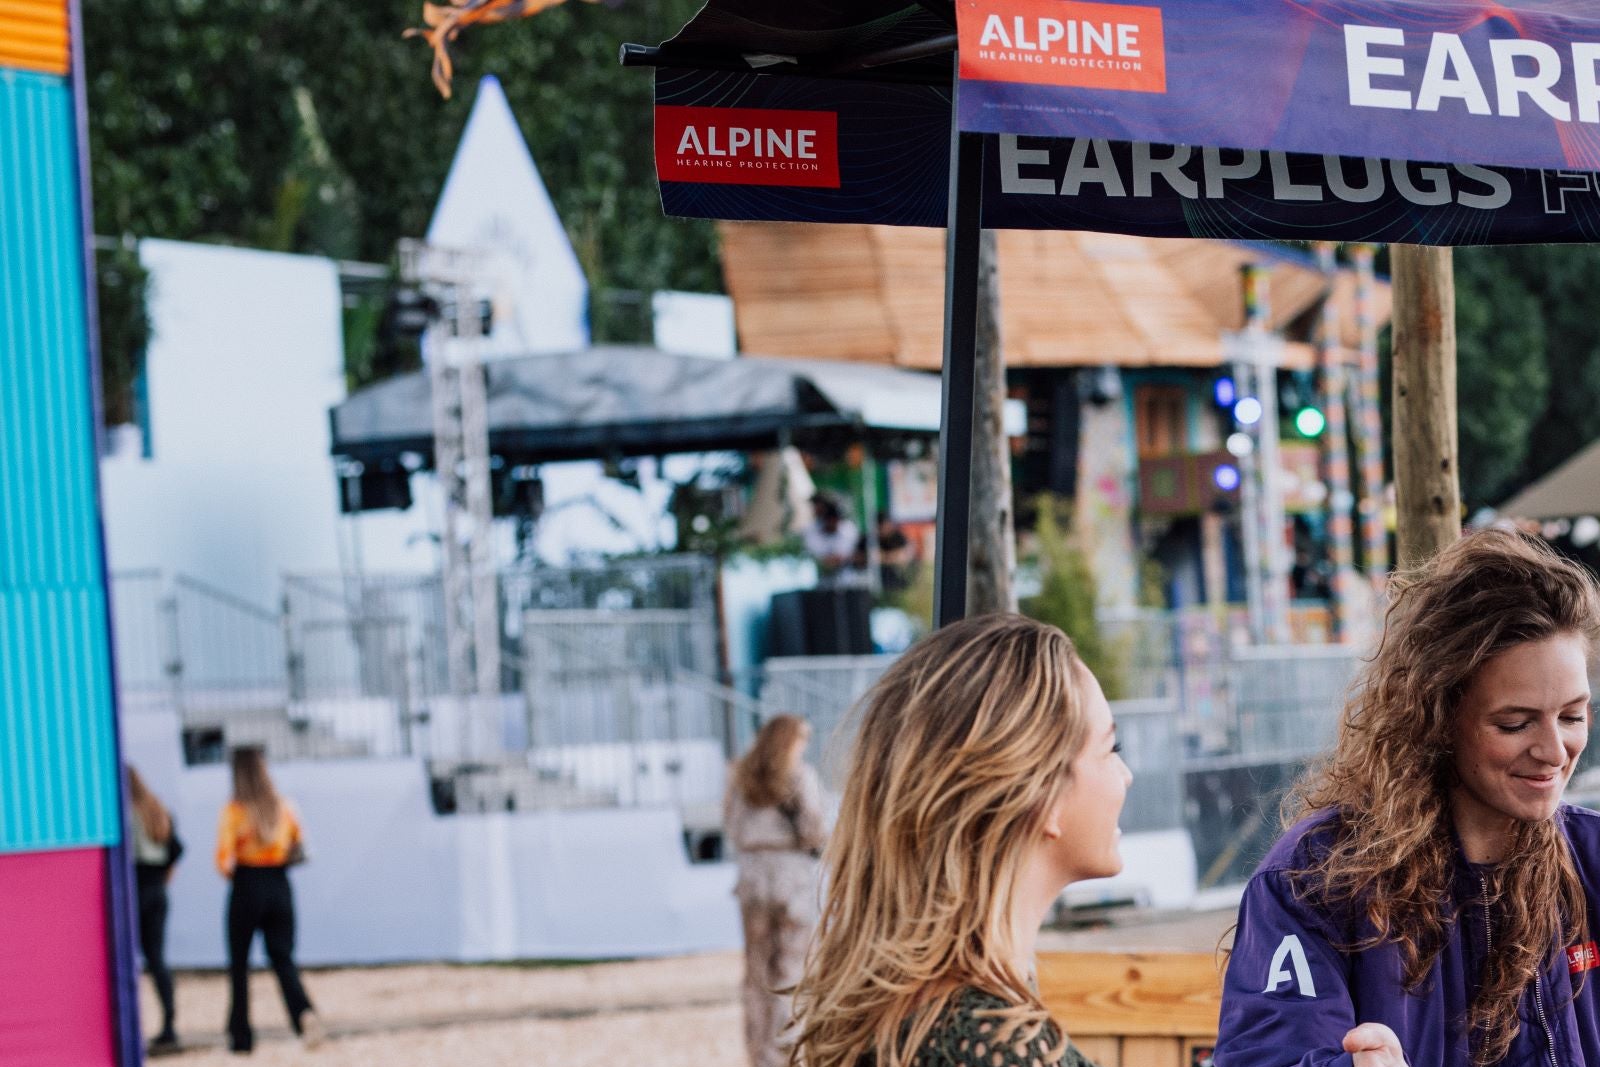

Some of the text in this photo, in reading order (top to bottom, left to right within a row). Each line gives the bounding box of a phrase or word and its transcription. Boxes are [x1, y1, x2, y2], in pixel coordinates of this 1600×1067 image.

[979, 14, 1141, 57] ALPINE
[979, 50, 1142, 71] HEARING PROTECTION
[676, 125, 817, 159] ALPINE
[676, 158, 819, 171] HEARING PROTECTION
[1000, 133, 1512, 209] EARPLUGS
[1261, 934, 1316, 998] A
